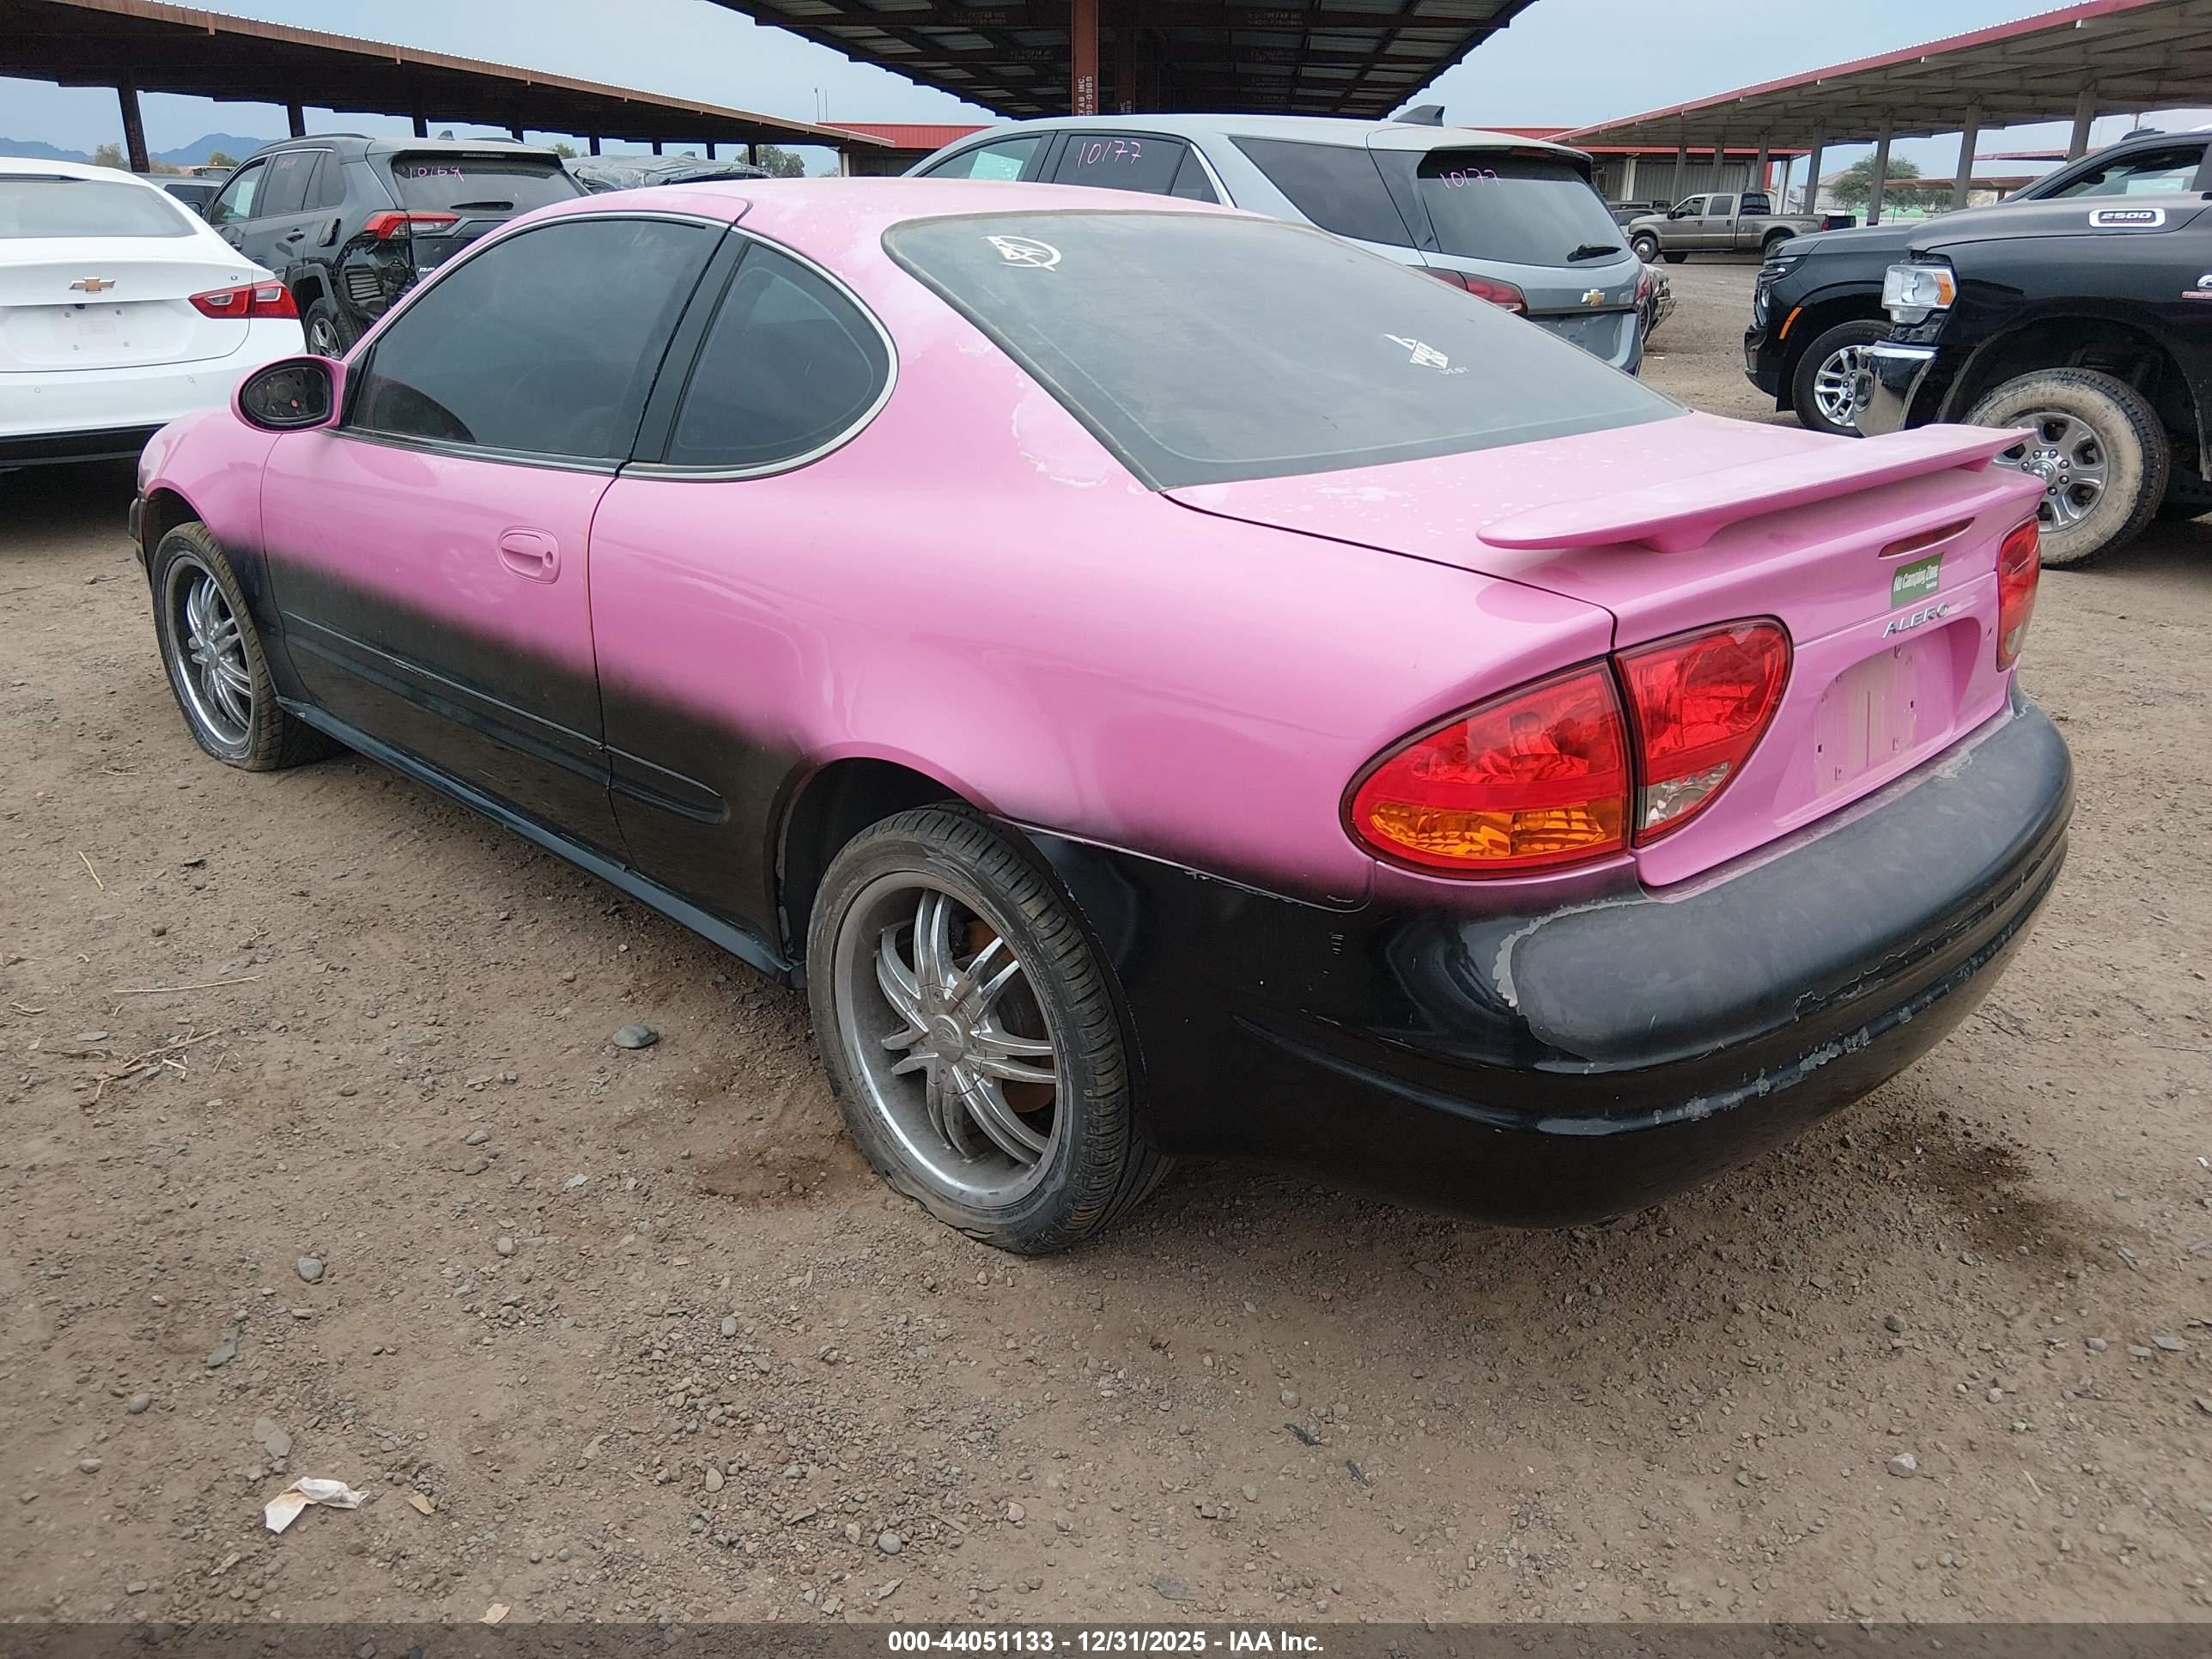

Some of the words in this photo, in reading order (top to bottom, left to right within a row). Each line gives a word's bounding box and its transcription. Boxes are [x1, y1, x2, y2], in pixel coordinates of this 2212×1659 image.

[1078, 140, 1141, 168] 10177
[1439, 167, 1500, 189] 10177
[1881, 603, 1948, 639] ALERO
